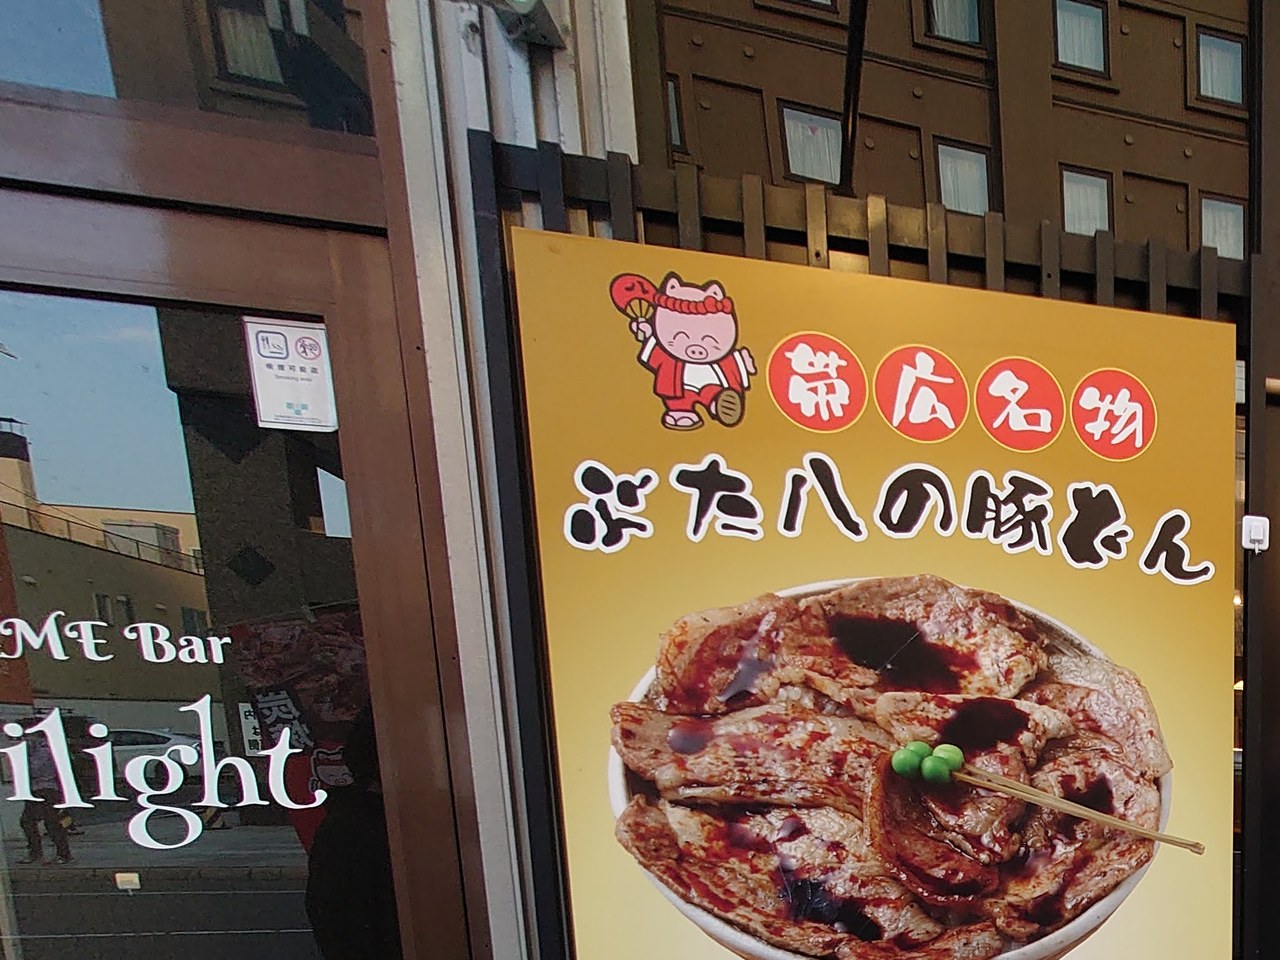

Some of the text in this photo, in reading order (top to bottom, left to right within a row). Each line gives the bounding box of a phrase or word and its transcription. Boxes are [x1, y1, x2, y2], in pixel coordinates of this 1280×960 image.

[785, 343, 1144, 449] 帯広名物
[566, 453, 1214, 585] ぶた八の豚どん
[123, 622, 232, 665] Bar
